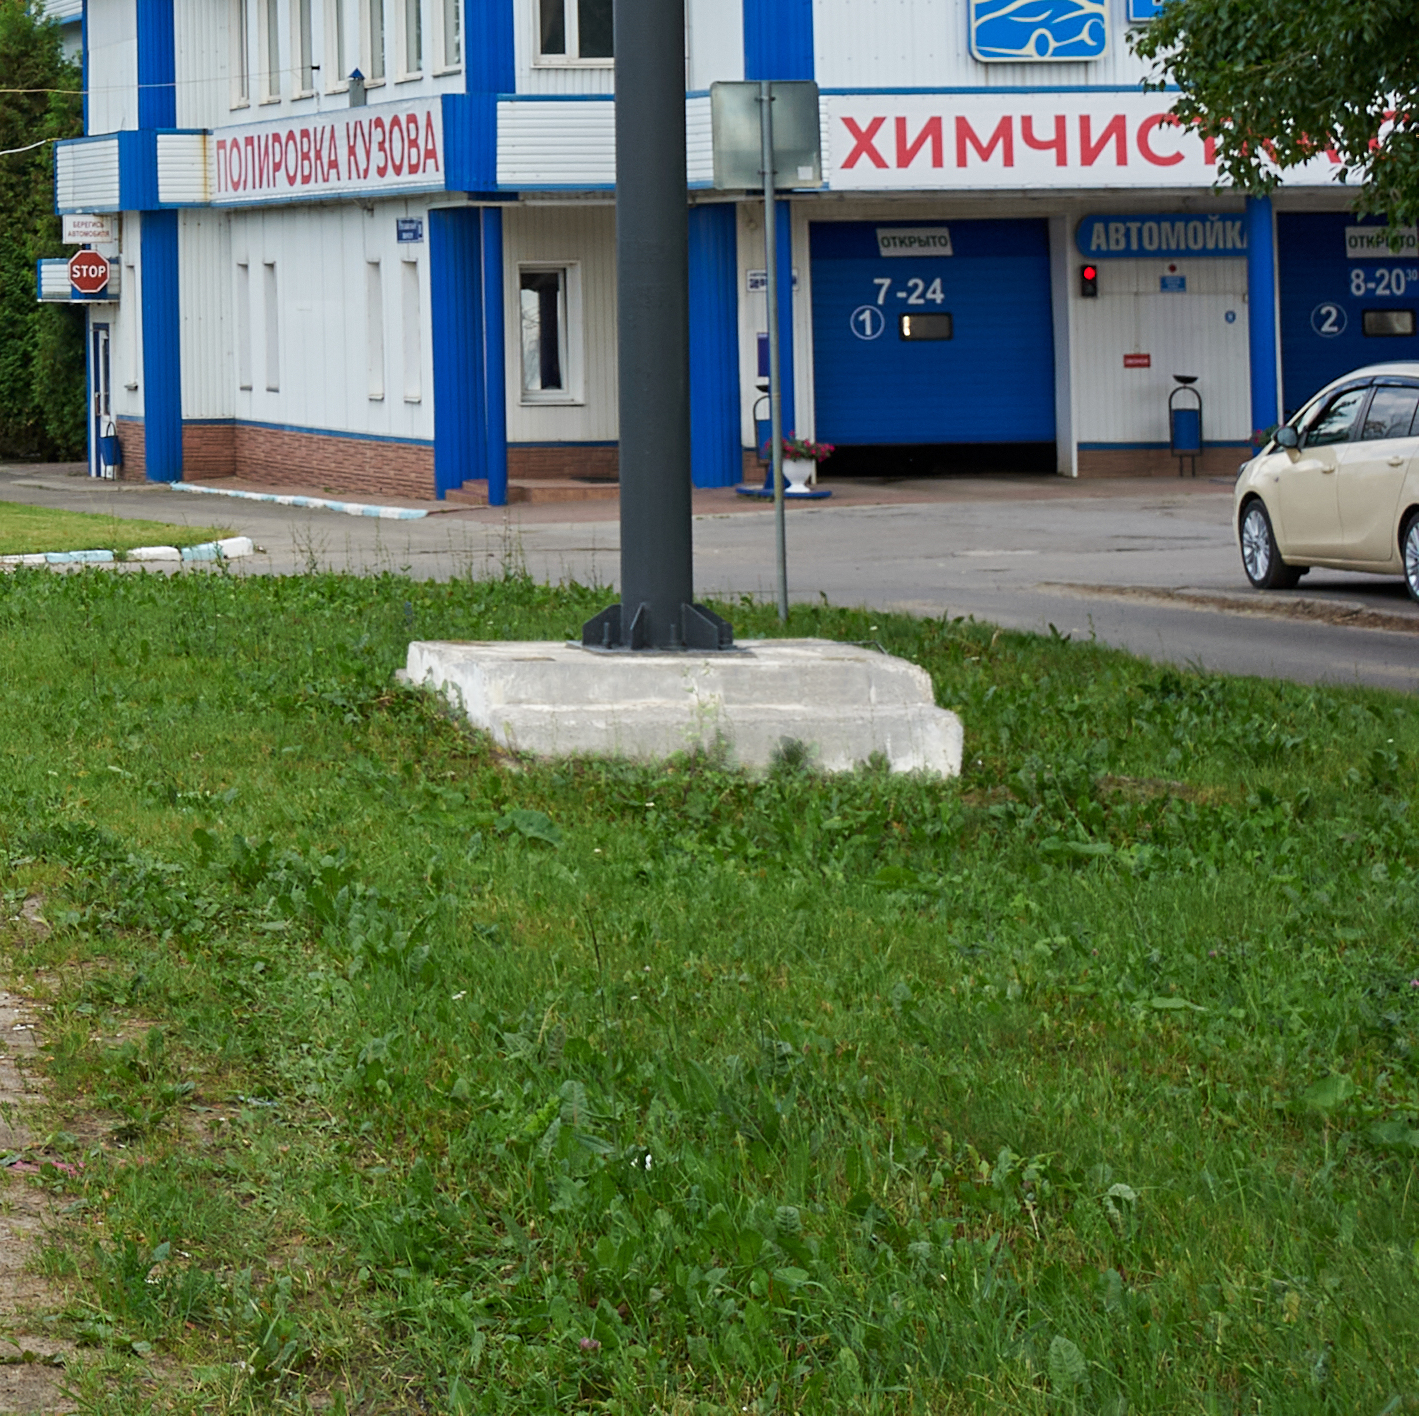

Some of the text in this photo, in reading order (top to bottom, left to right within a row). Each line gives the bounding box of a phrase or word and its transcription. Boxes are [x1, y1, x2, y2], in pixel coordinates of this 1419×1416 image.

[216, 110, 440, 192] ПОЛИРОВКА КУЗОВА
[880, 235, 949, 248] ОТКРЫТО
[1090, 214, 1248, 251] АВТОМОЙК
[71, 265, 107, 278] STOP
[1319, 305, 1339, 333] 2
